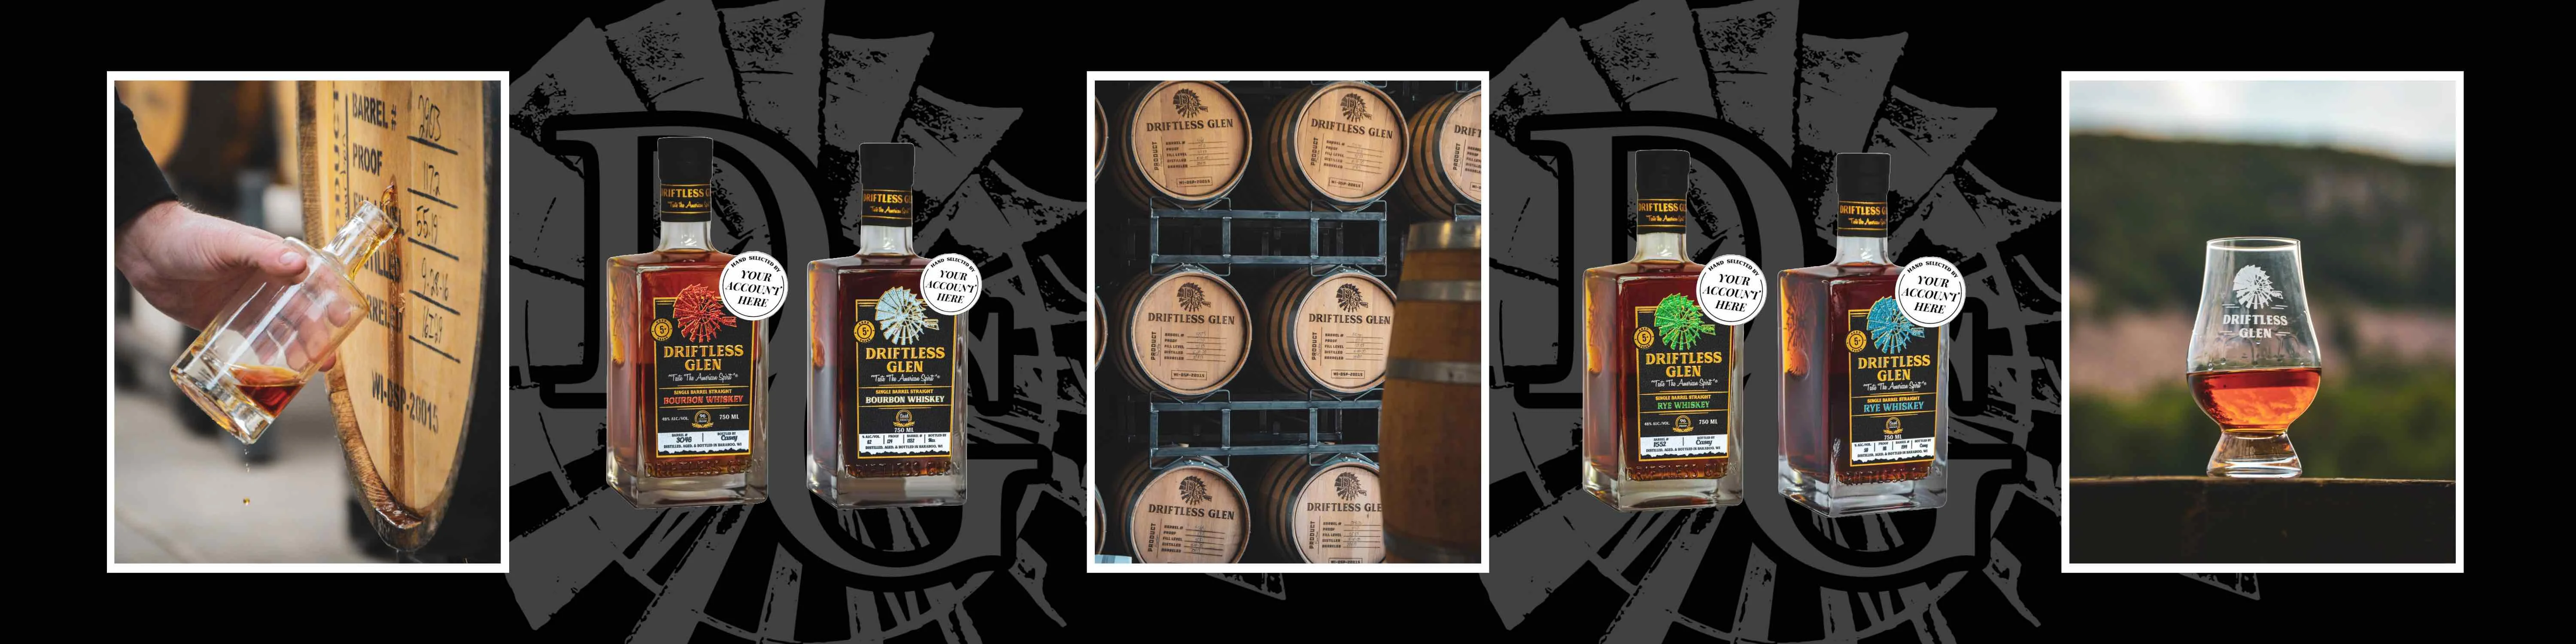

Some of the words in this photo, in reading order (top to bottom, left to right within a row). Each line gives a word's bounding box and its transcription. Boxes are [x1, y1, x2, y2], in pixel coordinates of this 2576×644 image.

[352, 92, 388, 129] BARREL
[391, 104, 396, 131] #
[419, 95, 441, 141] 2903
[1147, 120, 1204, 132] DRIFTLESS
[1208, 118, 1233, 128] GLEN
[1311, 118, 1365, 135] DRIFTLESS
[1369, 128, 1393, 140] GLEN
[1310, 137, 1318, 166] PRODUCT
[353, 143, 383, 176] PROOF
[1638, 203, 1678, 212] DRIFTLESS
[1840, 205, 1880, 215] DRIFTLESS
[365, 249, 401, 282] STILLED
[731, 258, 746, 267] HAND
[749, 256, 774, 266] SELECTED
[931, 258, 944, 267] HAND
[947, 258, 969, 266] SELECTED
[1708, 261, 1724, 271] HAND
[1727, 259, 1753, 270] SELECTED
[1908, 263, 1923, 273] HAND
[1926, 261, 1951, 272] SELECTED
[741, 270, 772, 282] YOUR
[940, 270, 967, 280] YOUR
[1719, 274, 1750, 286] YOUR
[925, 281, 977, 293] ACCOUNT
[1918, 276, 1949, 288] YOUR
[725, 282, 782, 295] ACCOUNT
[1703, 286, 1761, 300] ACCOUNT
[937, 293, 964, 303] HERE
[1902, 288, 1960, 302] ACCOUNT
[738, 296, 769, 307] HERE
[1715, 300, 1747, 312] HERE
[1914, 302, 1946, 314] HERE
[367, 295, 403, 334] RRELED
[1148, 313, 1204, 324] DRIFTLESS
[1208, 315, 1235, 325] GLEN
[1309, 313, 1362, 324] DRIFTLESS
[1366, 316, 1390, 325] GLEN
[2223, 315, 2287, 325] DRIFTLESS
[2239, 328, 2272, 338] GLEN
[664, 345, 744, 358] DRIFTLESS
[866, 347, 945, 359] DRIFTLESS
[1646, 352, 1722, 365] DRIFTLESS
[1858, 355, 1930, 369] DRIFTLESS
[685, 359, 721, 371] GLEN
[887, 361, 923, 373] GLEN
[695, 373, 718, 381] American
[1666, 366, 1701, 377] GLEN
[1877, 369, 1911, 381] GLEN
[1864, 404, 1880, 413] RYE
[1883, 402, 1924, 410] WHISKEY
[1148, 504, 1204, 516] DRIFTLESS
[1208, 509, 1234, 520] GLEN
[1307, 503, 1361, 512] DRIFTLESS
[1364, 503, 1382, 512] GLE
[1148, 522, 1156, 553] PRODUCT
